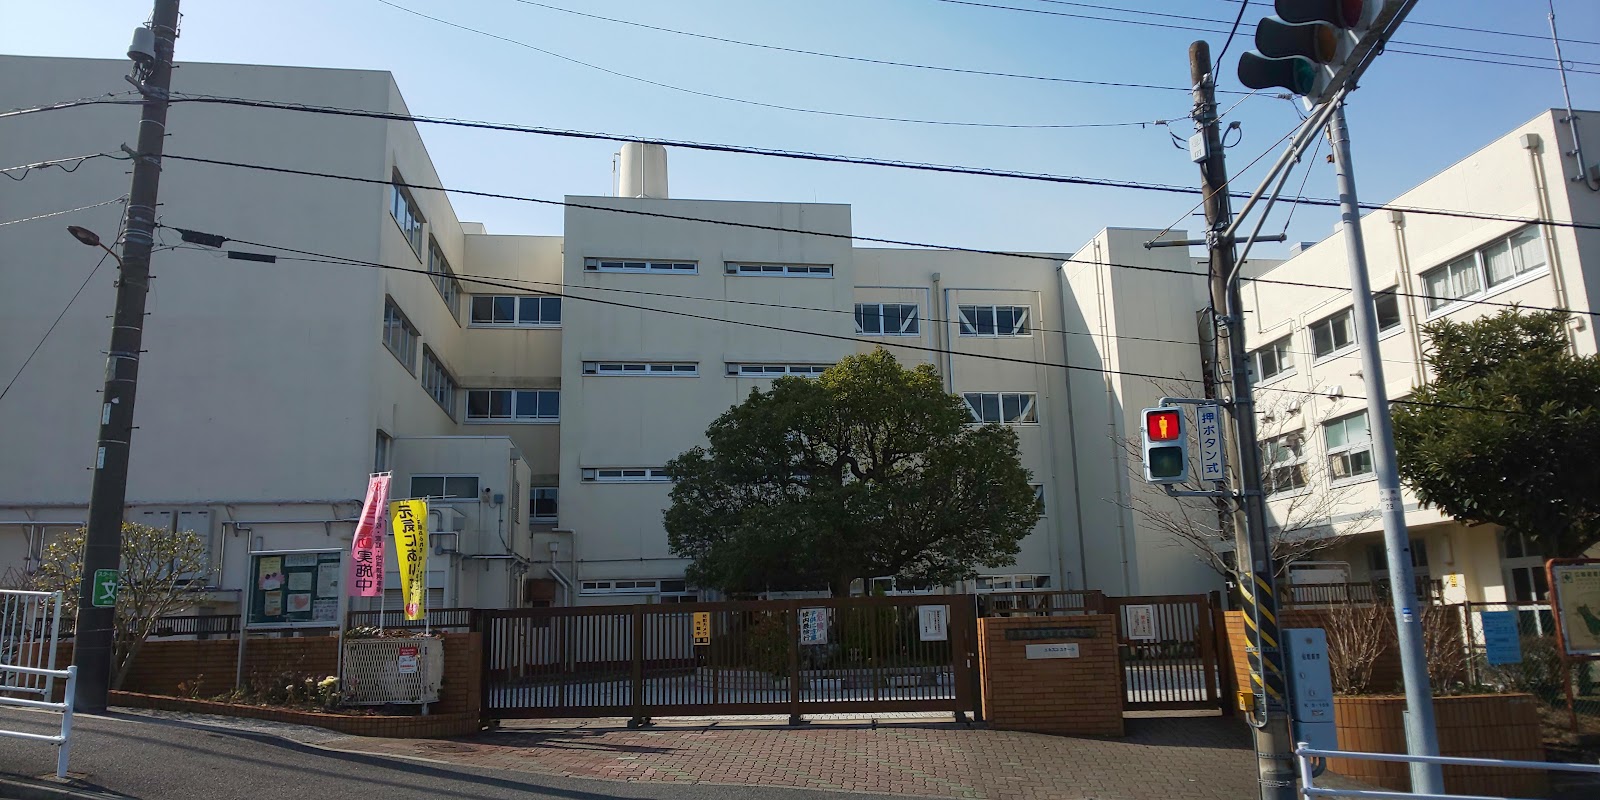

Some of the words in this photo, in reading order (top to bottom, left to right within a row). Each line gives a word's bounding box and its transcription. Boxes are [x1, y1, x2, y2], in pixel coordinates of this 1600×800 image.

[1202, 412, 1219, 474] 押ボタン式
[100, 580, 116, 599] 文
